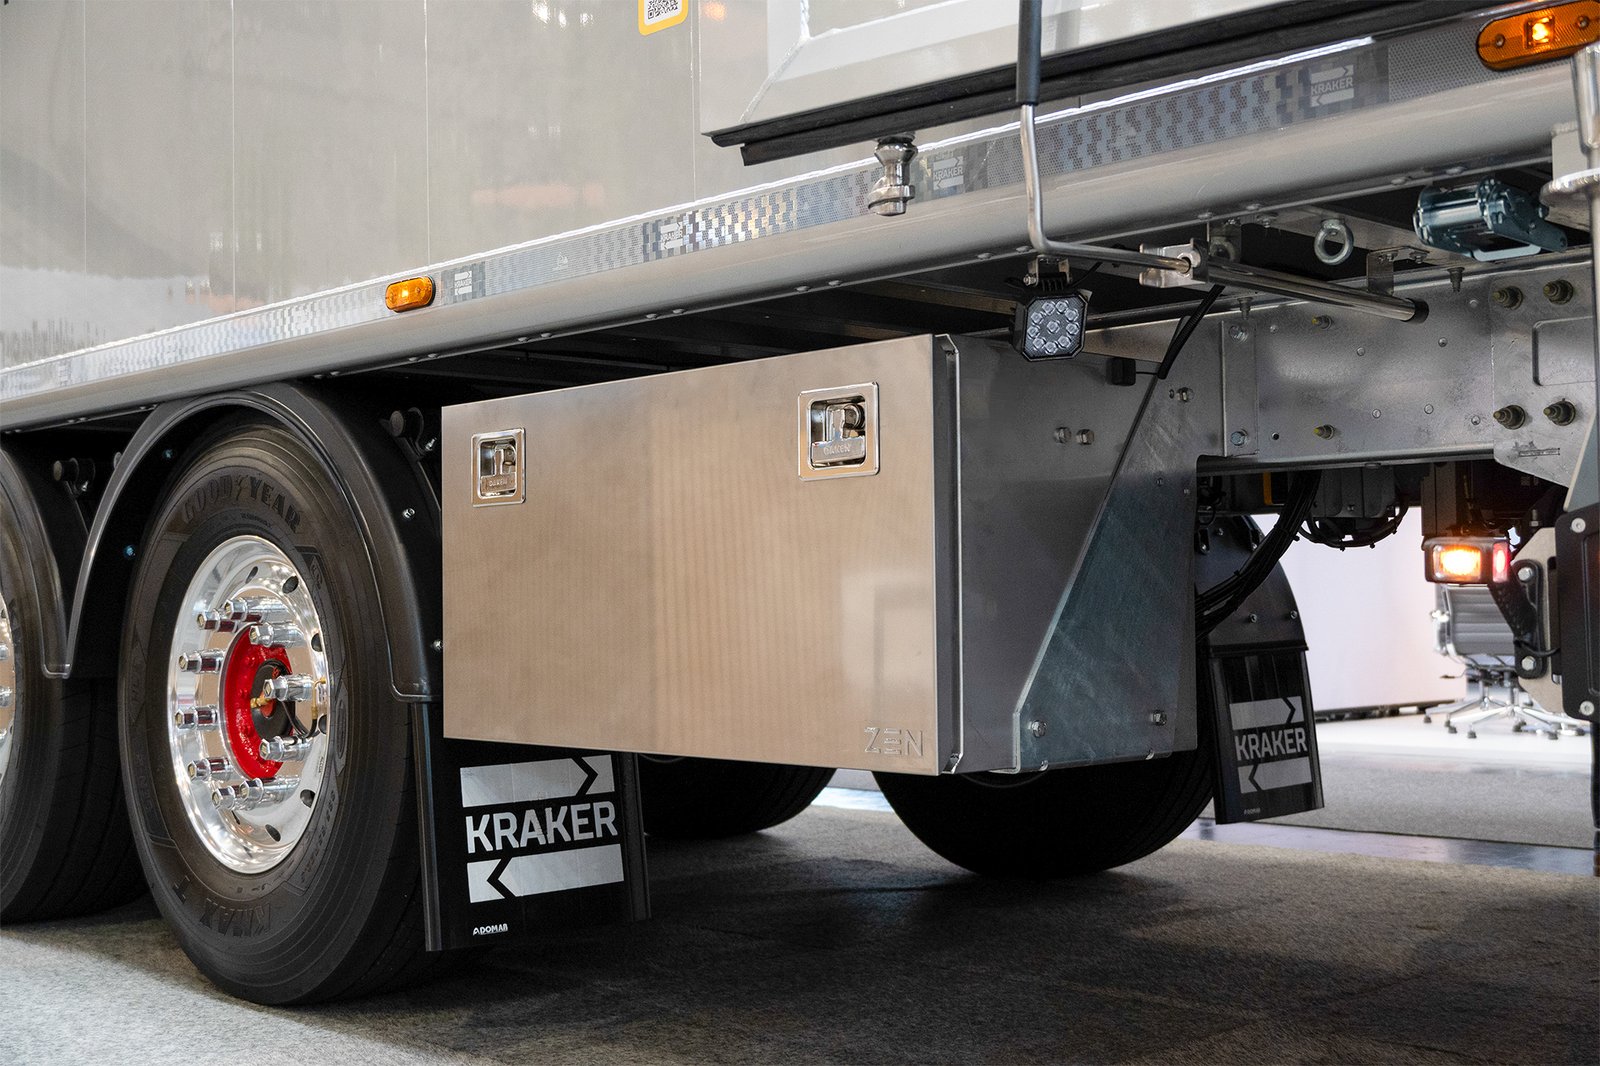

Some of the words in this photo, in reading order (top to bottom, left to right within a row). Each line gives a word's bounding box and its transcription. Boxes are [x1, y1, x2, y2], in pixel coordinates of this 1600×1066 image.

[1311, 77, 1353, 95] KRAKER
[933, 166, 964, 180] KRAKER
[864, 726, 923, 757] ZEN
[1234, 727, 1308, 761] KRAKER
[465, 801, 619, 854] KRAKER
